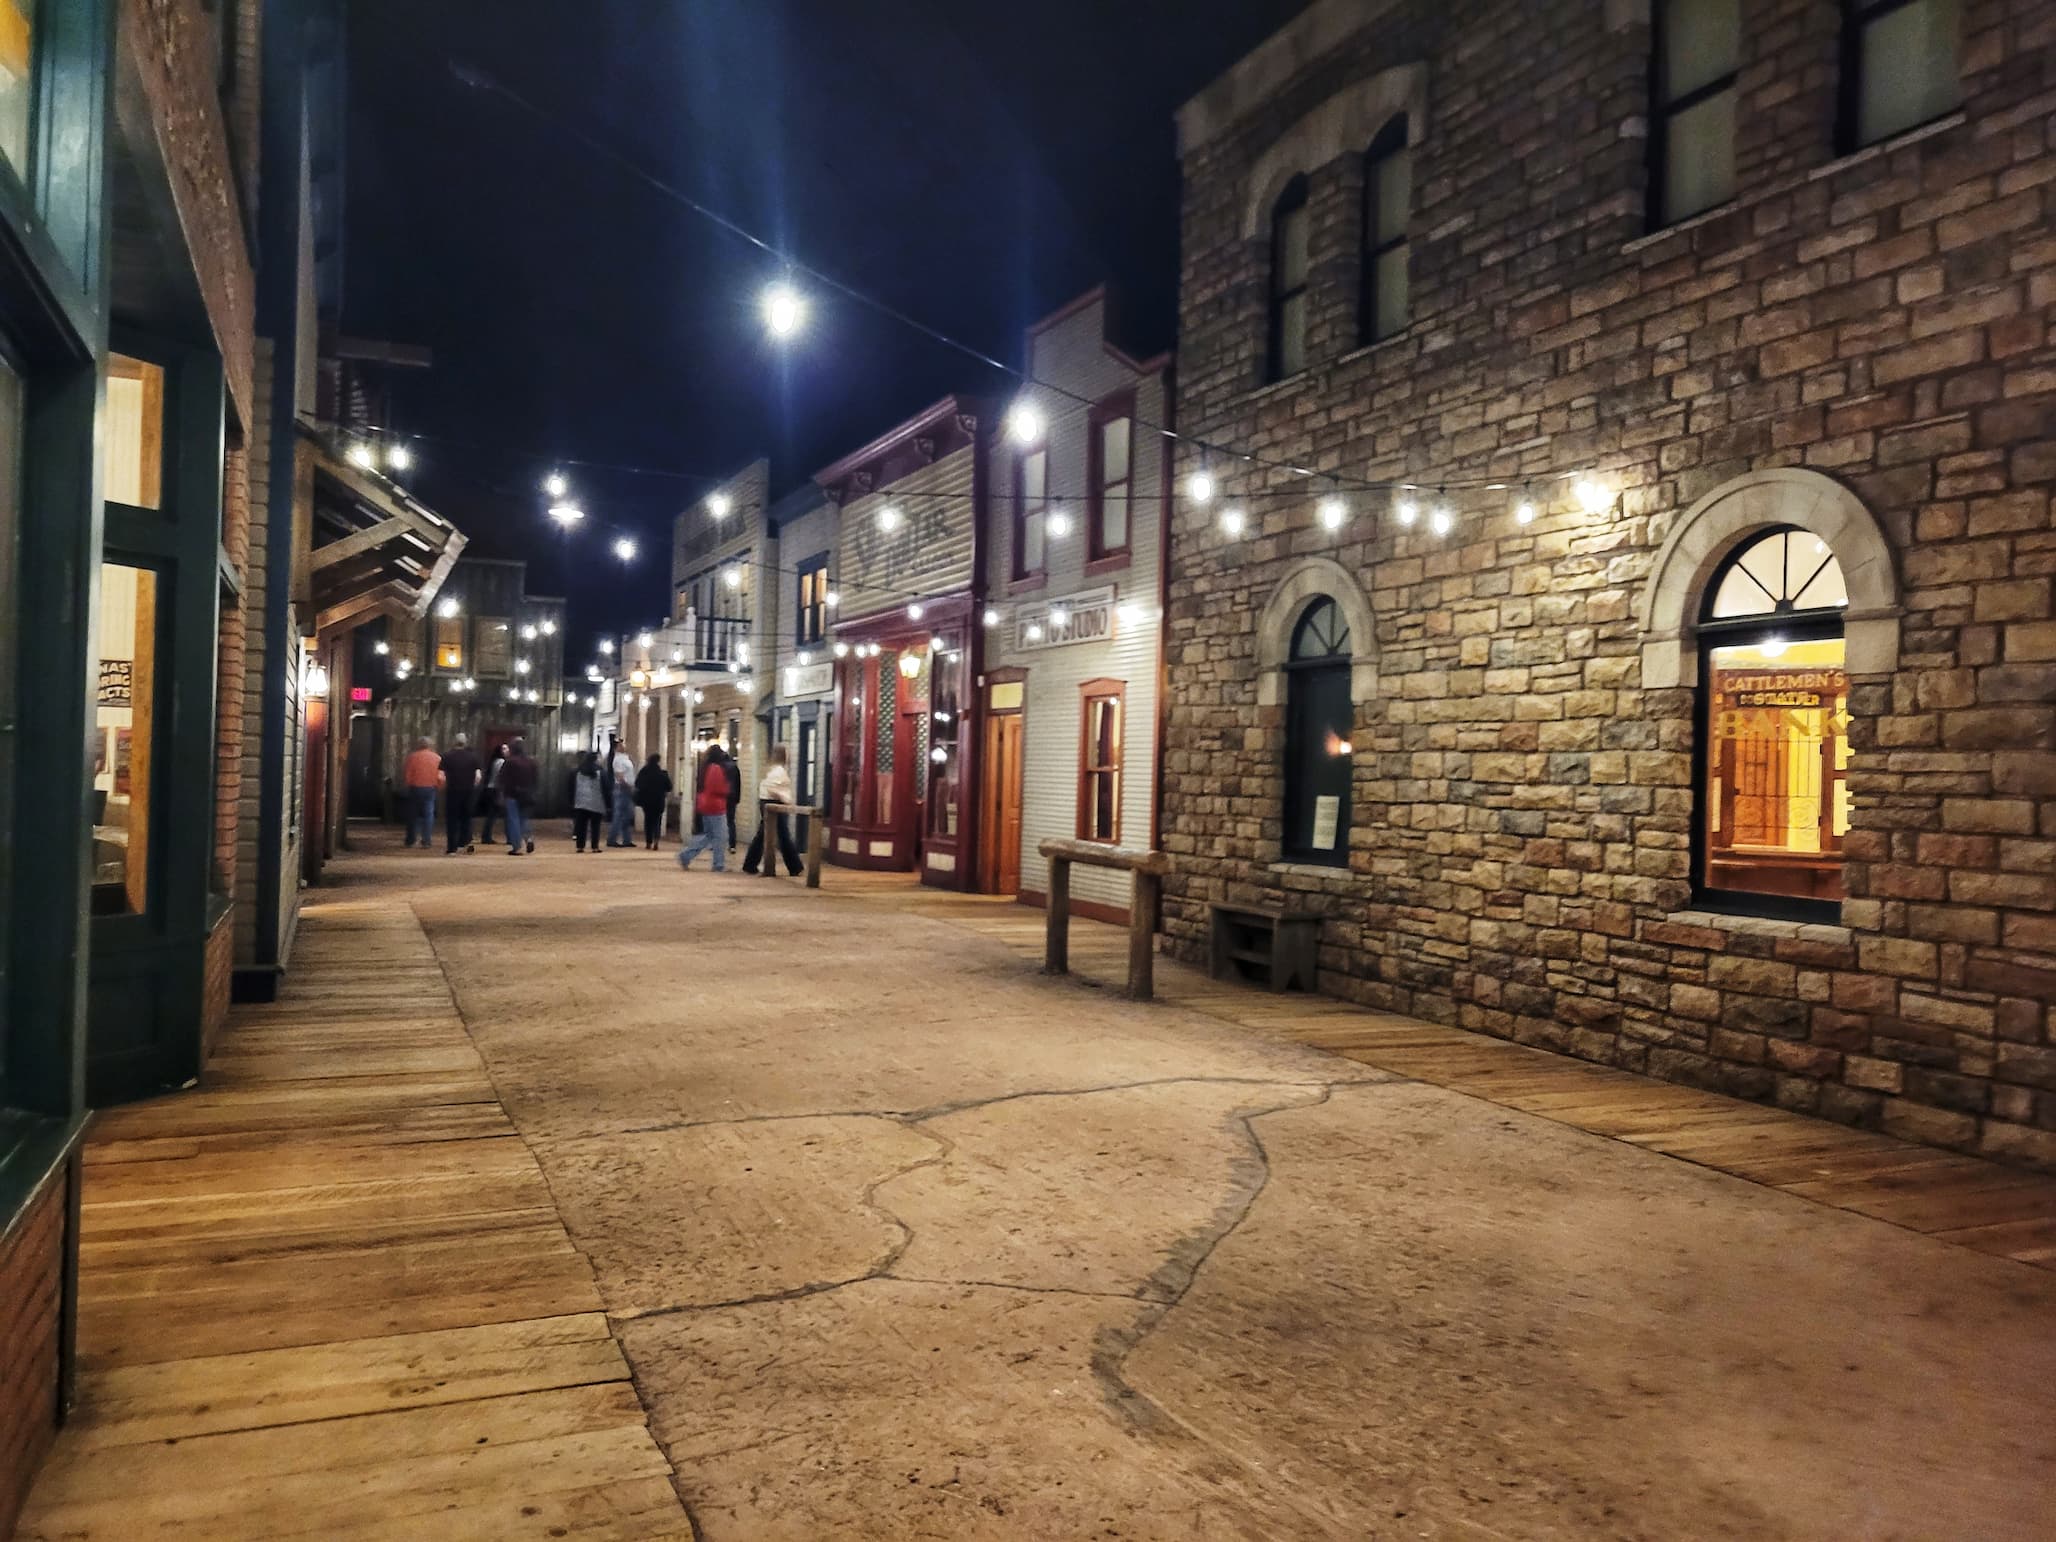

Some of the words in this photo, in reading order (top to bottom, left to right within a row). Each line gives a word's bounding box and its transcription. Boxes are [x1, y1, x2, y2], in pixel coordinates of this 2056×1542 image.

[1018, 615, 1060, 648] PTO
[99, 662, 132, 674] NAS
[1724, 672, 1845, 692] CATTLEMEN'S
[1717, 708, 1847, 739] BANK
